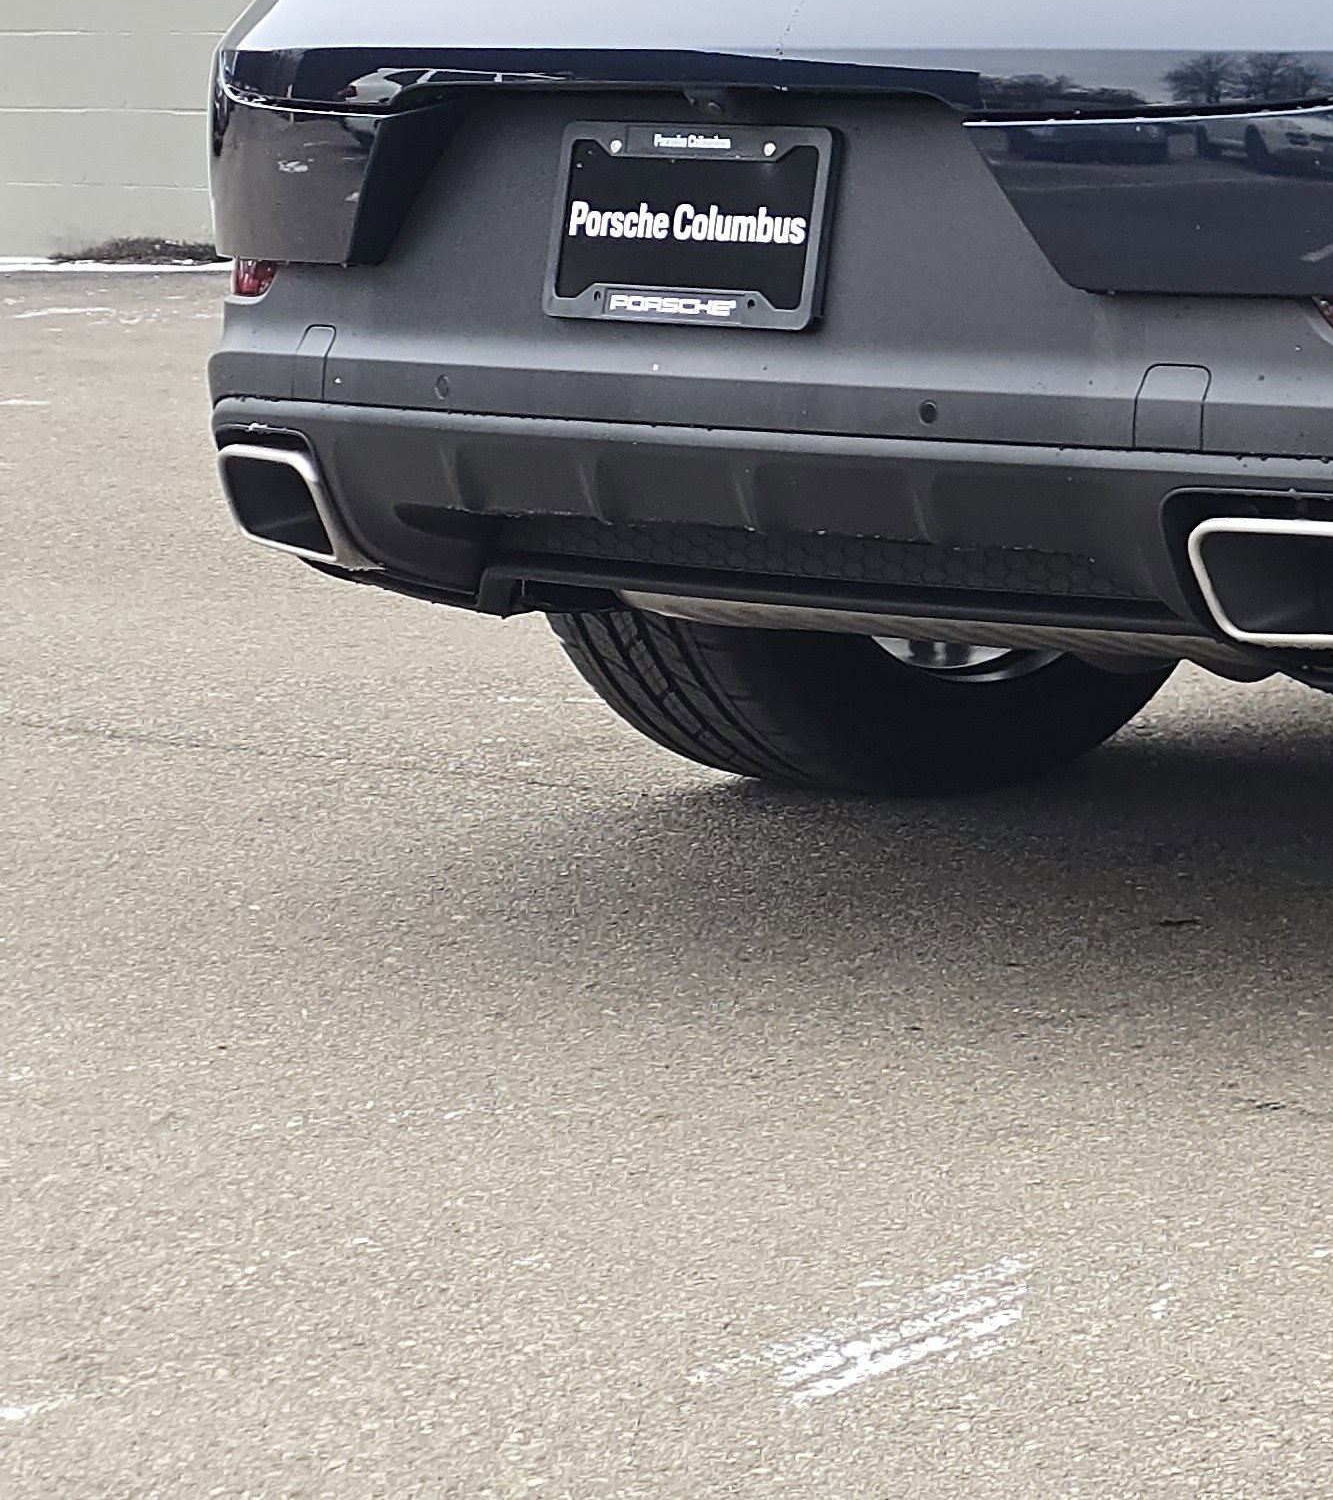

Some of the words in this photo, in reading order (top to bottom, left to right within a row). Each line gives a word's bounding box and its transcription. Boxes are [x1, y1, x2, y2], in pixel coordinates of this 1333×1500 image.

[568, 201, 669, 239] Porsche
[673, 203, 806, 244] Columbus
[609, 294, 737, 316] PORSCHE
